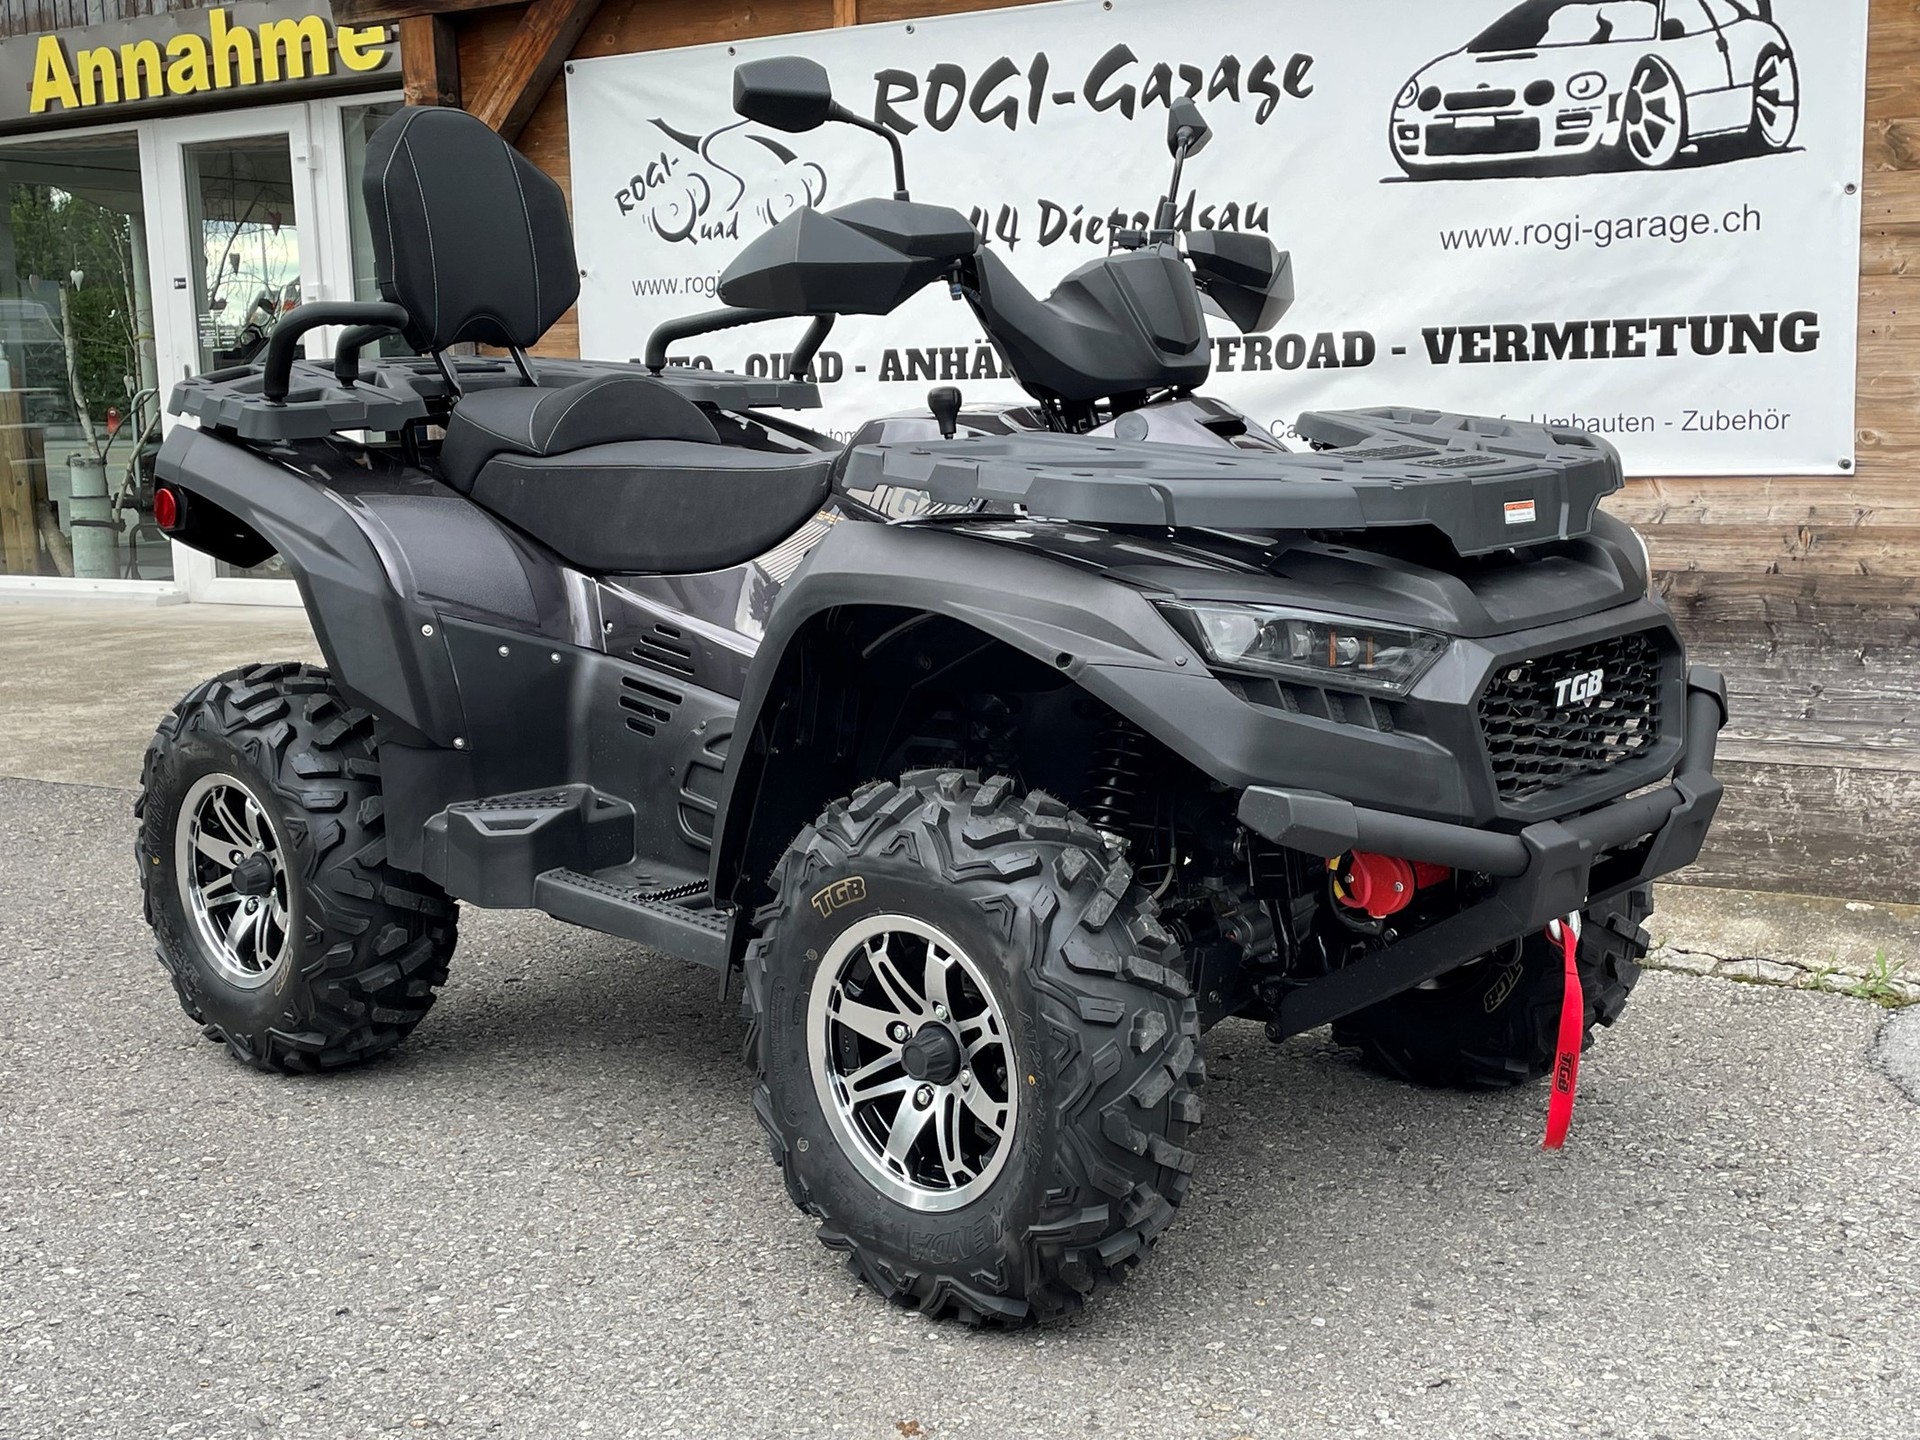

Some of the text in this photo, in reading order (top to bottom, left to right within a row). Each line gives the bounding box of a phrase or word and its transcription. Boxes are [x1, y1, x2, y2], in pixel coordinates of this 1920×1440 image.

[29, 8, 386, 113] Annahme
[874, 43, 1314, 135] ROGI-Garage
[614, 152, 679, 216] ROGI-
[1440, 203, 1762, 250] www.rogi-garage.ch
[1209, 331, 1376, 373] FROAD
[1421, 311, 1820, 364] VERMIETUNG
[1681, 409, 1790, 431] Zubehör
[1554, 668, 1604, 708] TGB
[811, 876, 866, 918] TGB
[1484, 963, 1523, 1013] TGB
[1555, 1052, 1575, 1094] TGB
